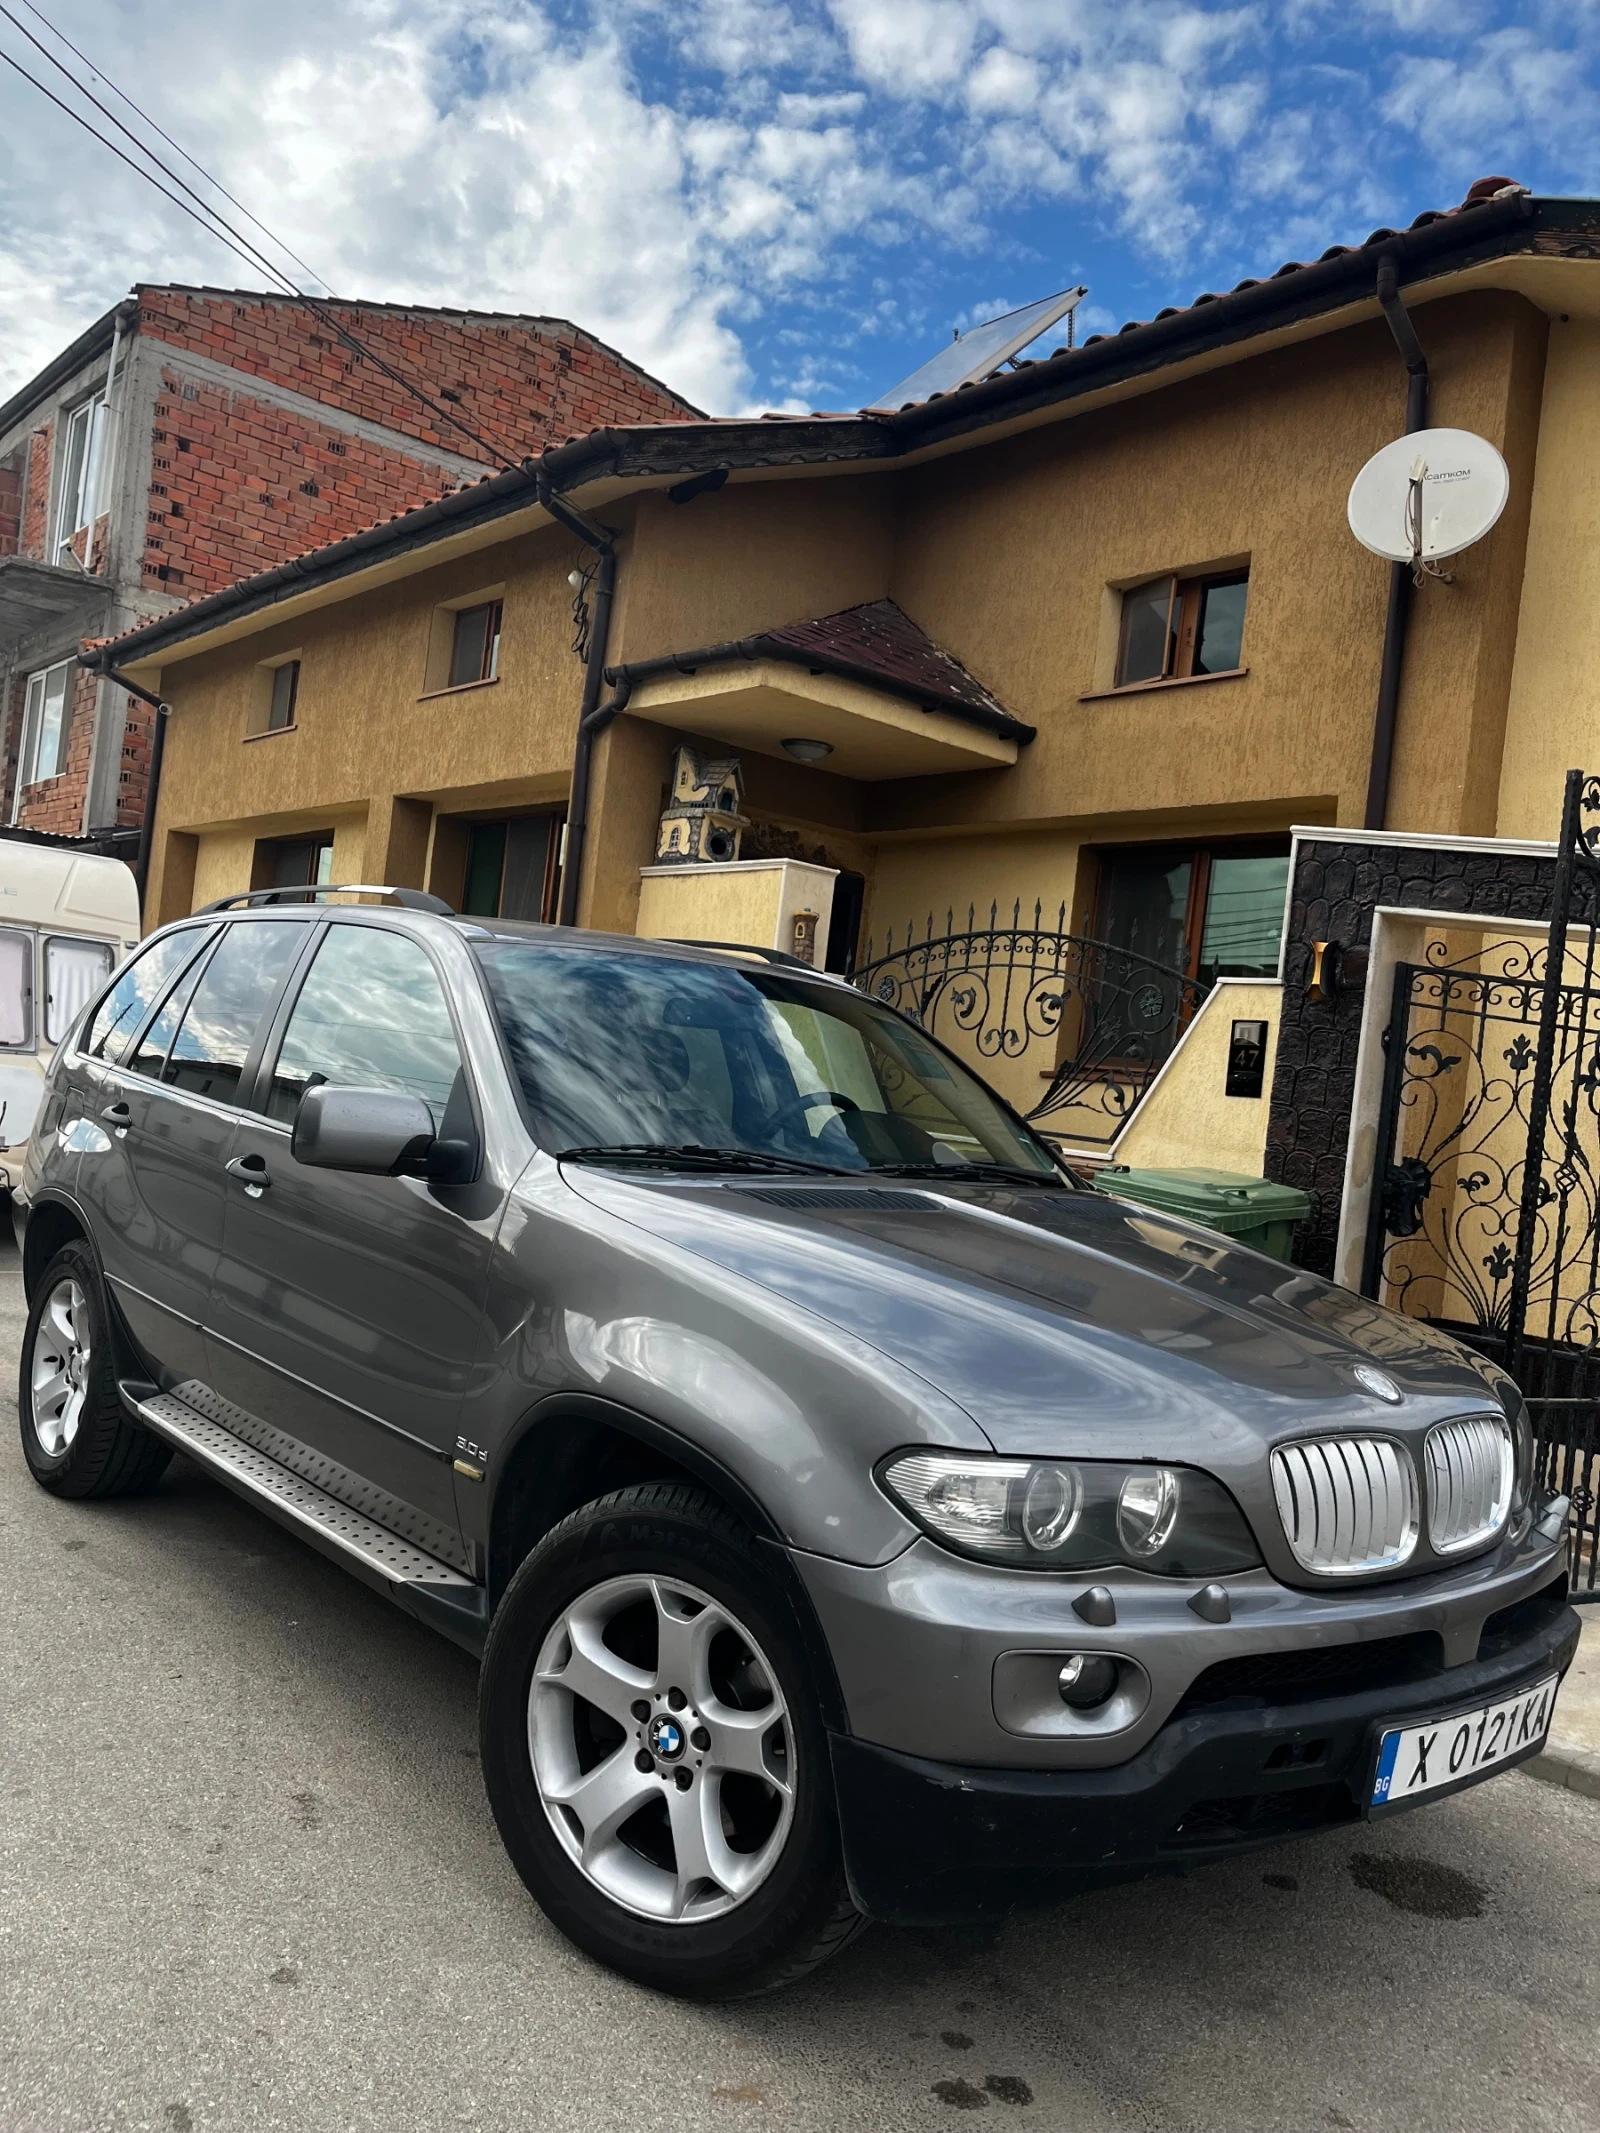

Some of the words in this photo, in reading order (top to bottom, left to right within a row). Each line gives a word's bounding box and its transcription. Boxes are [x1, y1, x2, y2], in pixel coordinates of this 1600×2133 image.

[1234, 1049, 1260, 1068] 47
[652, 1719, 664, 1754] BMW
[1407, 1731, 1439, 1788] X
[1373, 1775, 1391, 1795] BG
